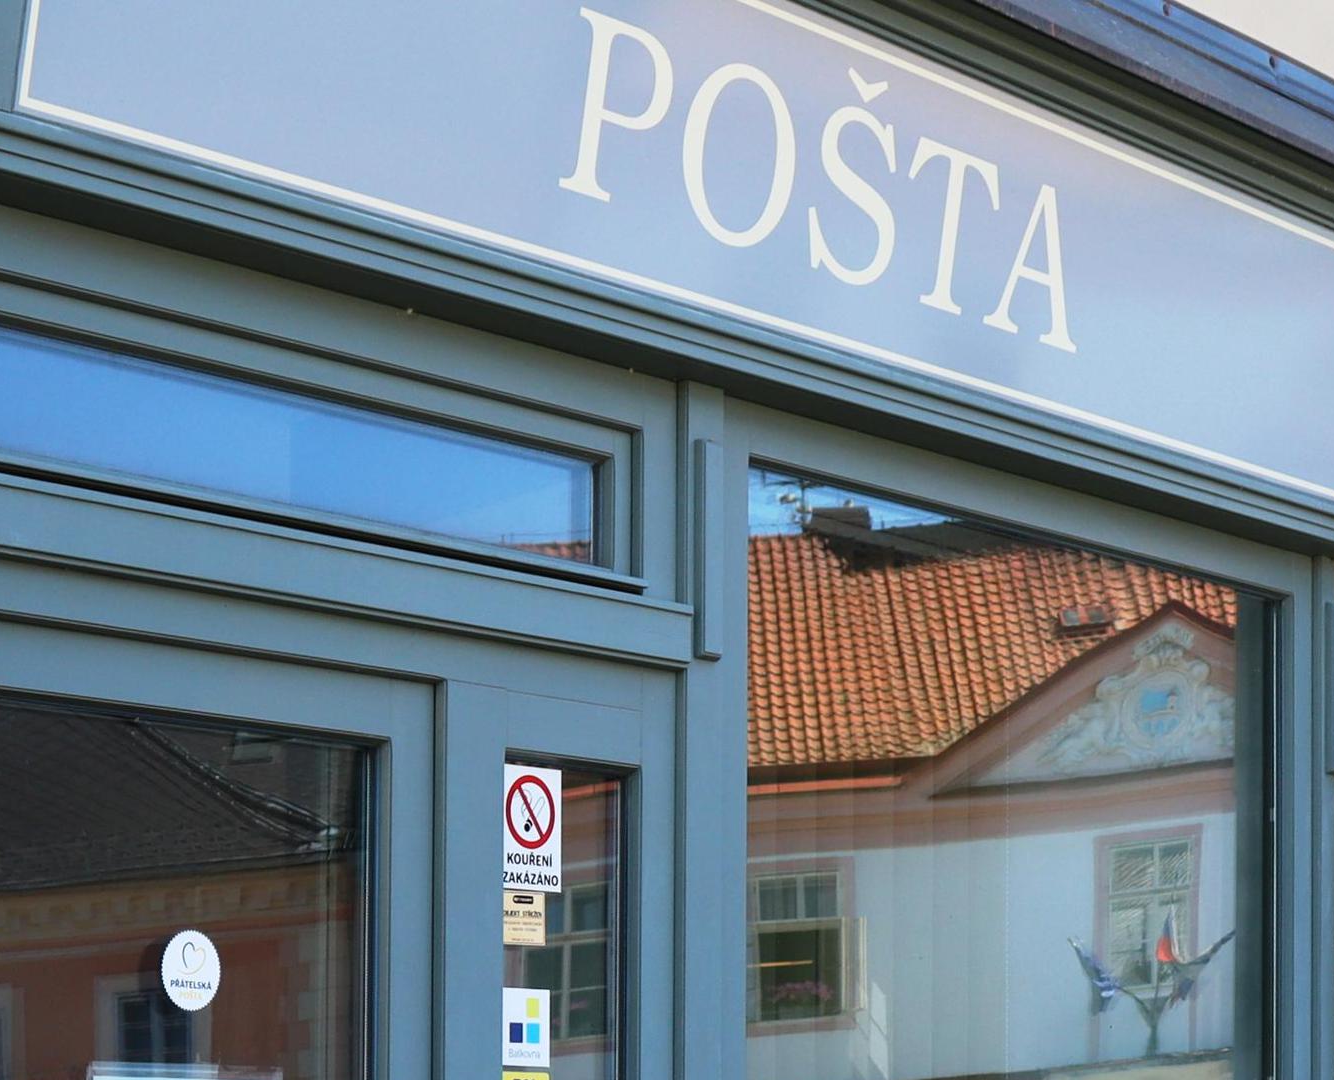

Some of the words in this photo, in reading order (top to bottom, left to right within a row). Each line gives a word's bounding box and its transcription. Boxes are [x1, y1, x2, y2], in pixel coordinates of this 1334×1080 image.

[558, 6, 1078, 353] POŠTA
[506, 852, 553, 867] KOUŘENÍ
[503, 871, 559, 887] ZAKÁZÁNO
[170, 978, 212, 991] PŘÁTELSKÁ
